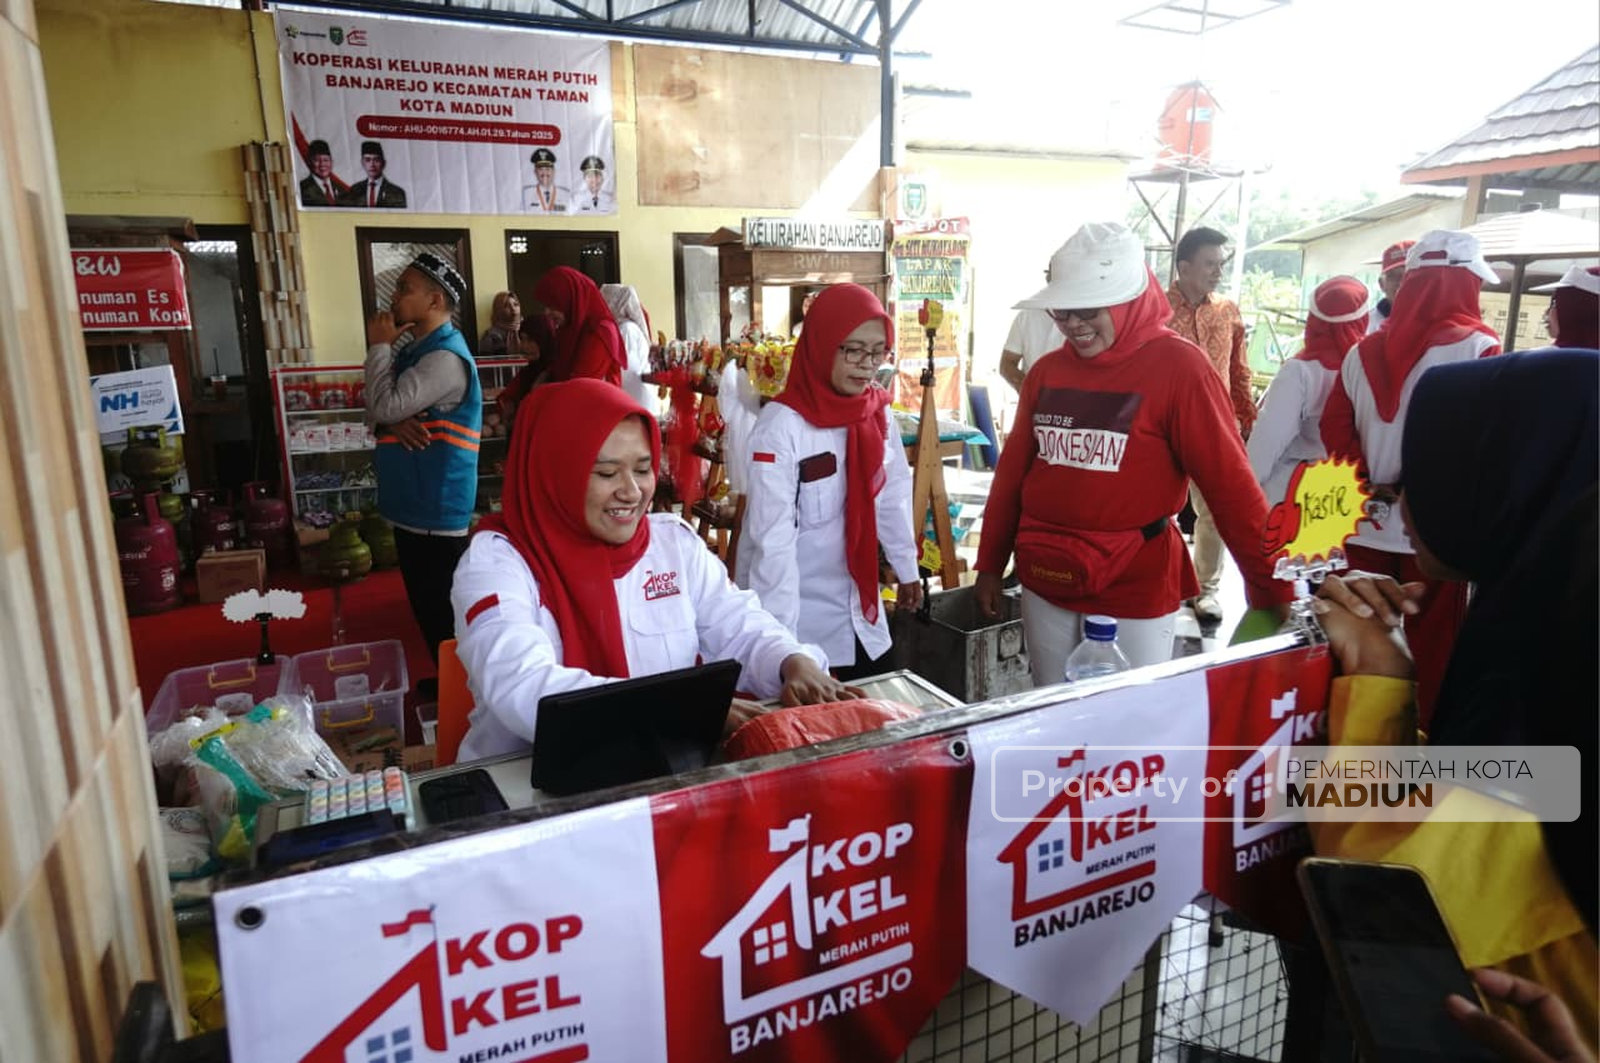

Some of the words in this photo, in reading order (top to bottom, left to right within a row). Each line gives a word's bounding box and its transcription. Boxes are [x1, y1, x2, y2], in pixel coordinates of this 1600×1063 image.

[293, 52, 383, 71] KOPERASI
[388, 59, 489, 79] KELURAHAN
[494, 67, 548, 83] MERAH
[553, 71, 598, 86] PUTIH
[326, 74, 428, 93] BANJAREJO
[433, 81, 532, 99] KECAMATAN
[537, 88, 589, 103] TAMAN
[368, 122, 397, 133] Nomor
[400, 98, 446, 113] KOTA
[450, 101, 513, 117] MADIUN
[748, 220, 817, 247] KELURAHAN
[820, 223, 882, 248] BANJAREJO
[147, 289, 169, 304] Es
[101, 391, 139, 413] NH
[655, 571, 677, 583] KOP
[1086, 754, 1165, 802] KOP
[1086, 805, 1157, 850] KEL
[811, 822, 914, 877] KOP
[1086, 855, 1124, 876] MERAH
[1126, 843, 1156, 862] PUTIH
[813, 876, 907, 935] KEL
[1014, 881, 1155, 948] BANJAREJO
[446, 914, 583, 976] KOP
[819, 934, 868, 964] MERAH
[871, 922, 910, 947] PUTIH
[451, 975, 582, 1037] KEL
[730, 967, 912, 1055] BANJAREJO
[458, 1037, 526, 1063] MERAH
[531, 1022, 585, 1047] PUTIH
